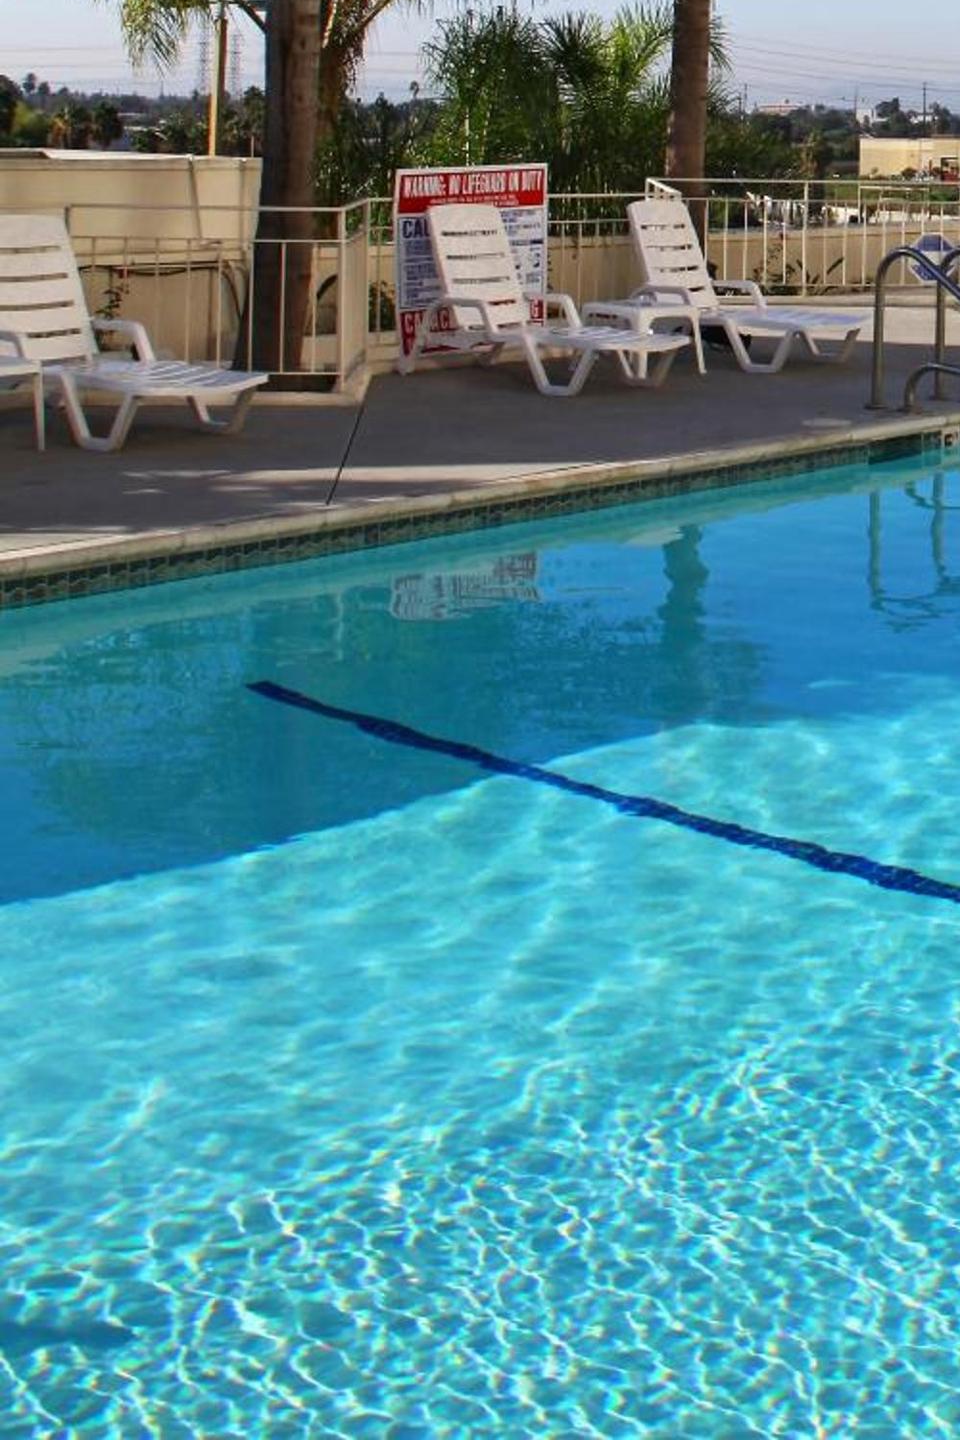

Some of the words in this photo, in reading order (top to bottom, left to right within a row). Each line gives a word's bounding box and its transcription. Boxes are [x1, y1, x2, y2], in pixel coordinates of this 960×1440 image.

[448, 174, 461, 196] NO
[462, 172, 506, 195] LIFEGUARD
[508, 171, 519, 192] ON
[521, 169, 542, 192] DUTY
